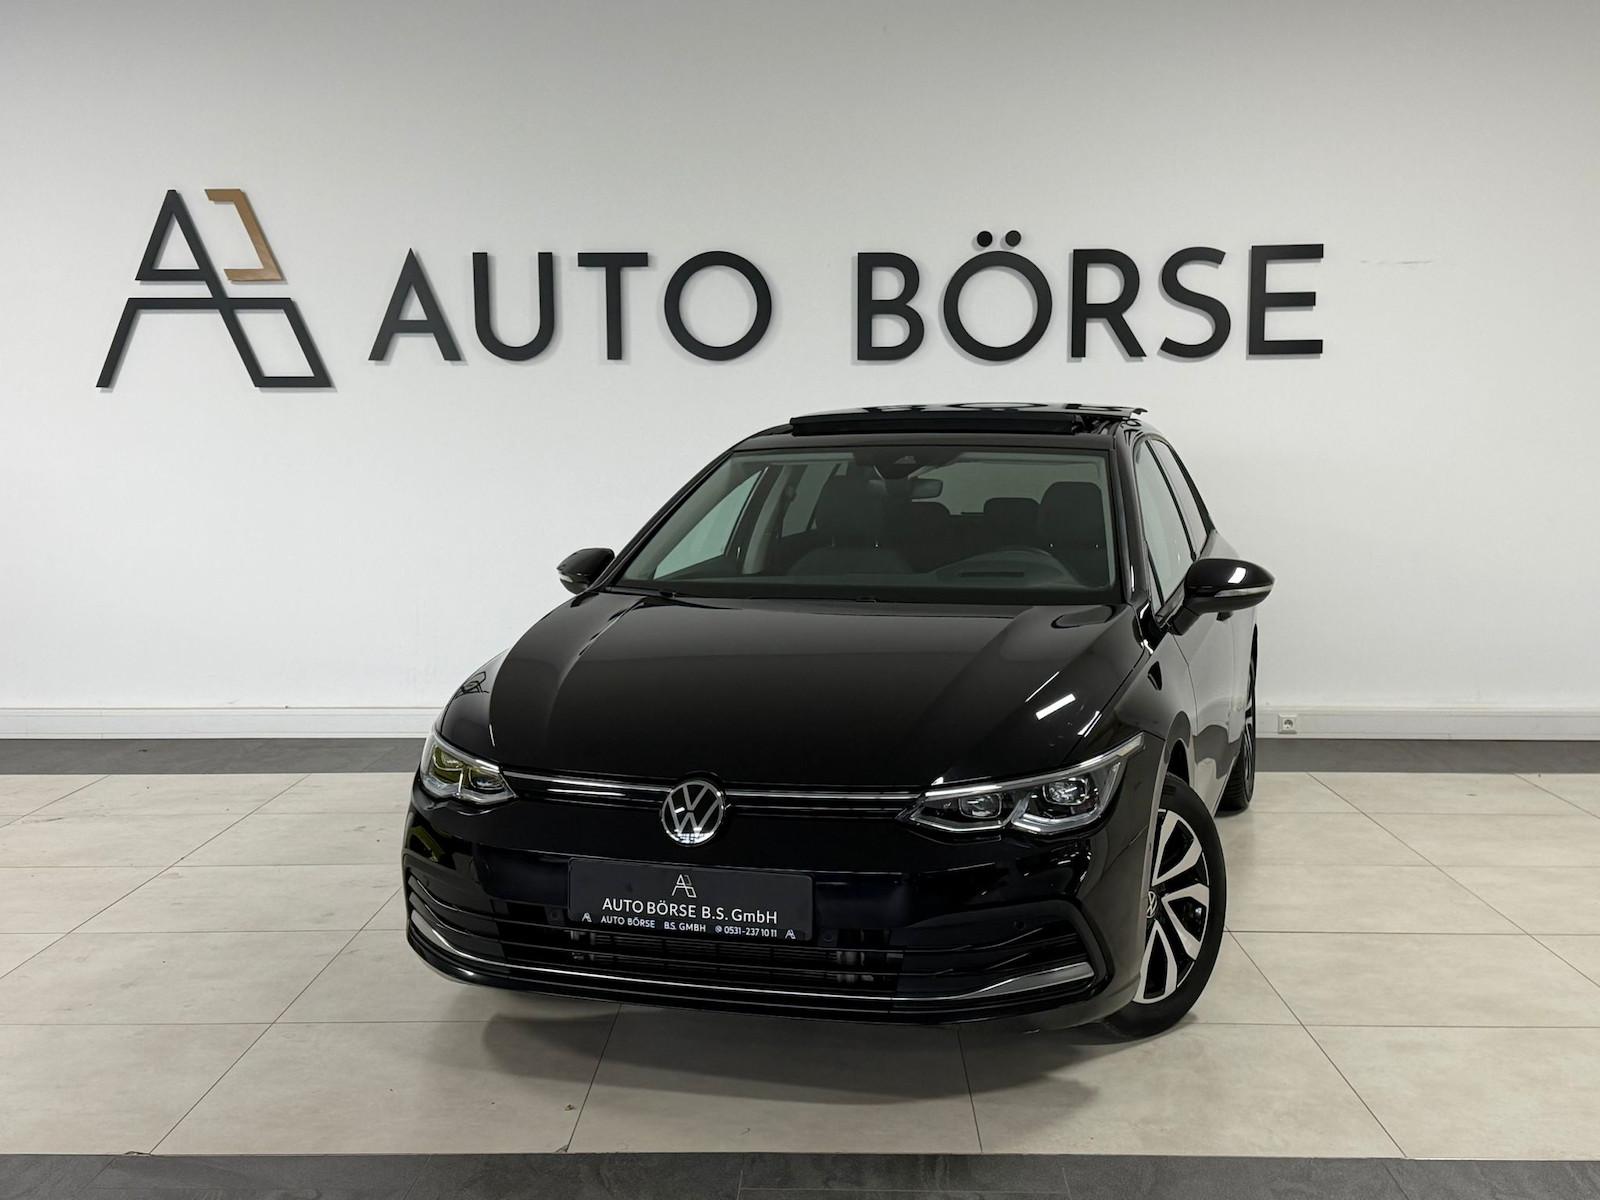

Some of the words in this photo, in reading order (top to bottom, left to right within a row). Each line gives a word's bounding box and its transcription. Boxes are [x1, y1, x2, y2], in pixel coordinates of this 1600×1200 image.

[368, 248, 773, 362] AUTO
[857, 230, 1324, 362] BÖRSE
[602, 898, 643, 913] AUTO
[647, 900, 696, 918] BÖRSE
[702, 906, 728, 920] B.S.
[731, 908, 777, 924] GmbH
[601, 916, 625, 925] AUTO
[627, 917, 655, 928] BÖRSE
[679, 922, 706, 932] GMBH
[724, 926, 759, 936] 0531-237
[761, 928, 769, 937] 10
